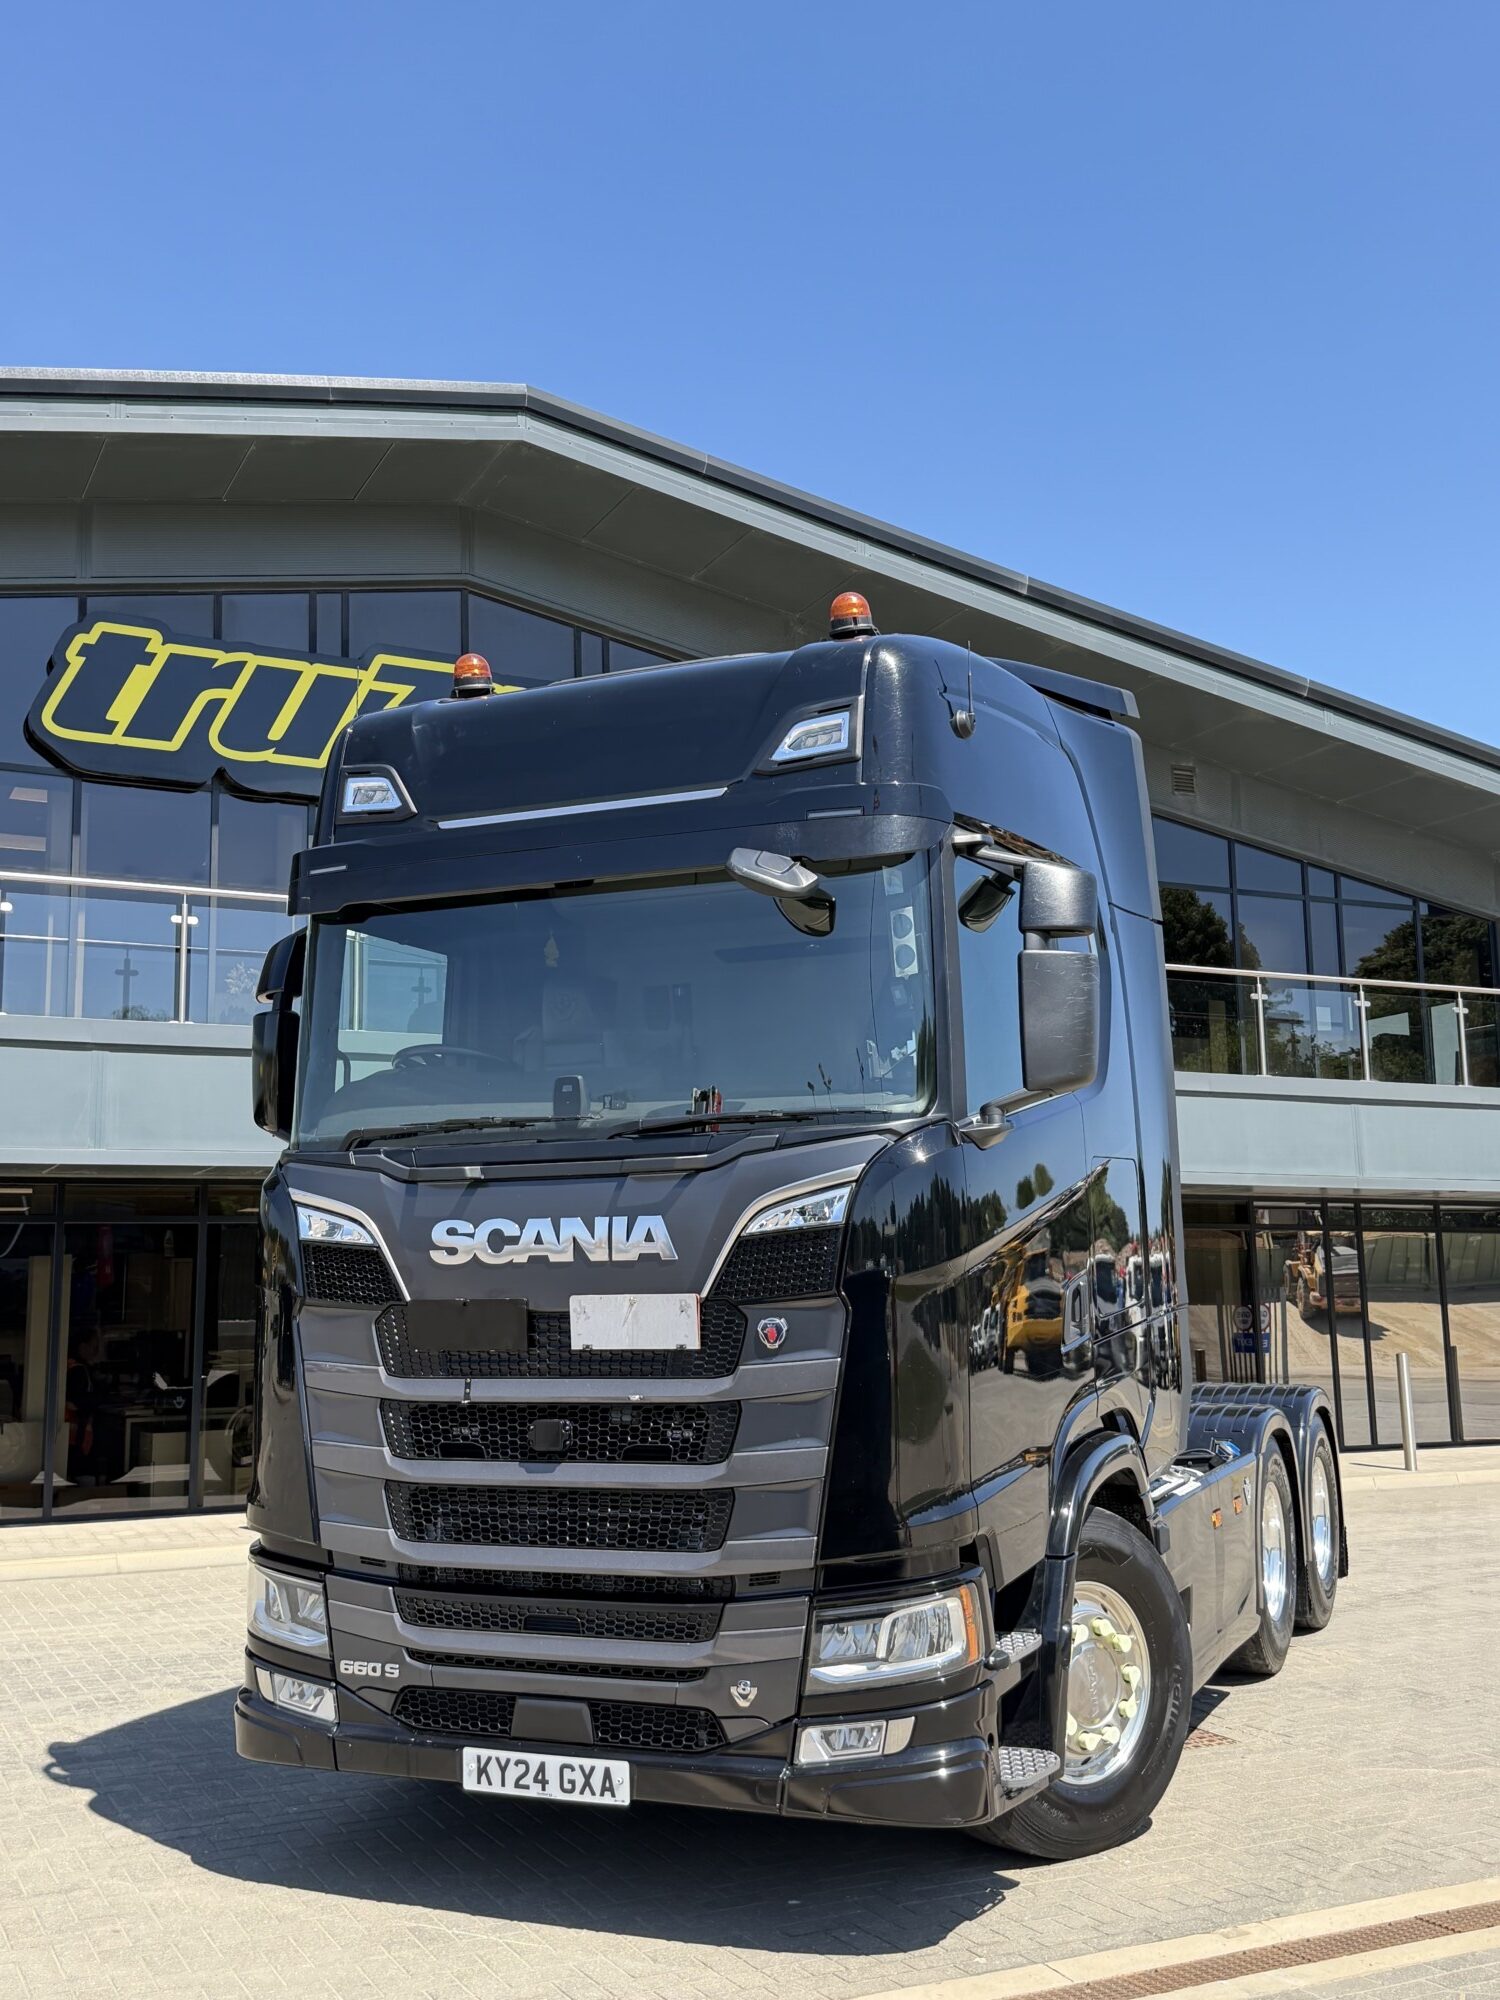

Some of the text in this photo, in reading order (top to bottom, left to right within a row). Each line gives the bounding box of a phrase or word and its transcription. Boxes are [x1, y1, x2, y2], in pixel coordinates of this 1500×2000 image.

[41, 621, 515, 768] tru
[429, 1215, 679, 1265] SCANIA
[340, 1659, 400, 1678] 660 S
[476, 1754, 617, 1799] KY24 GXA
